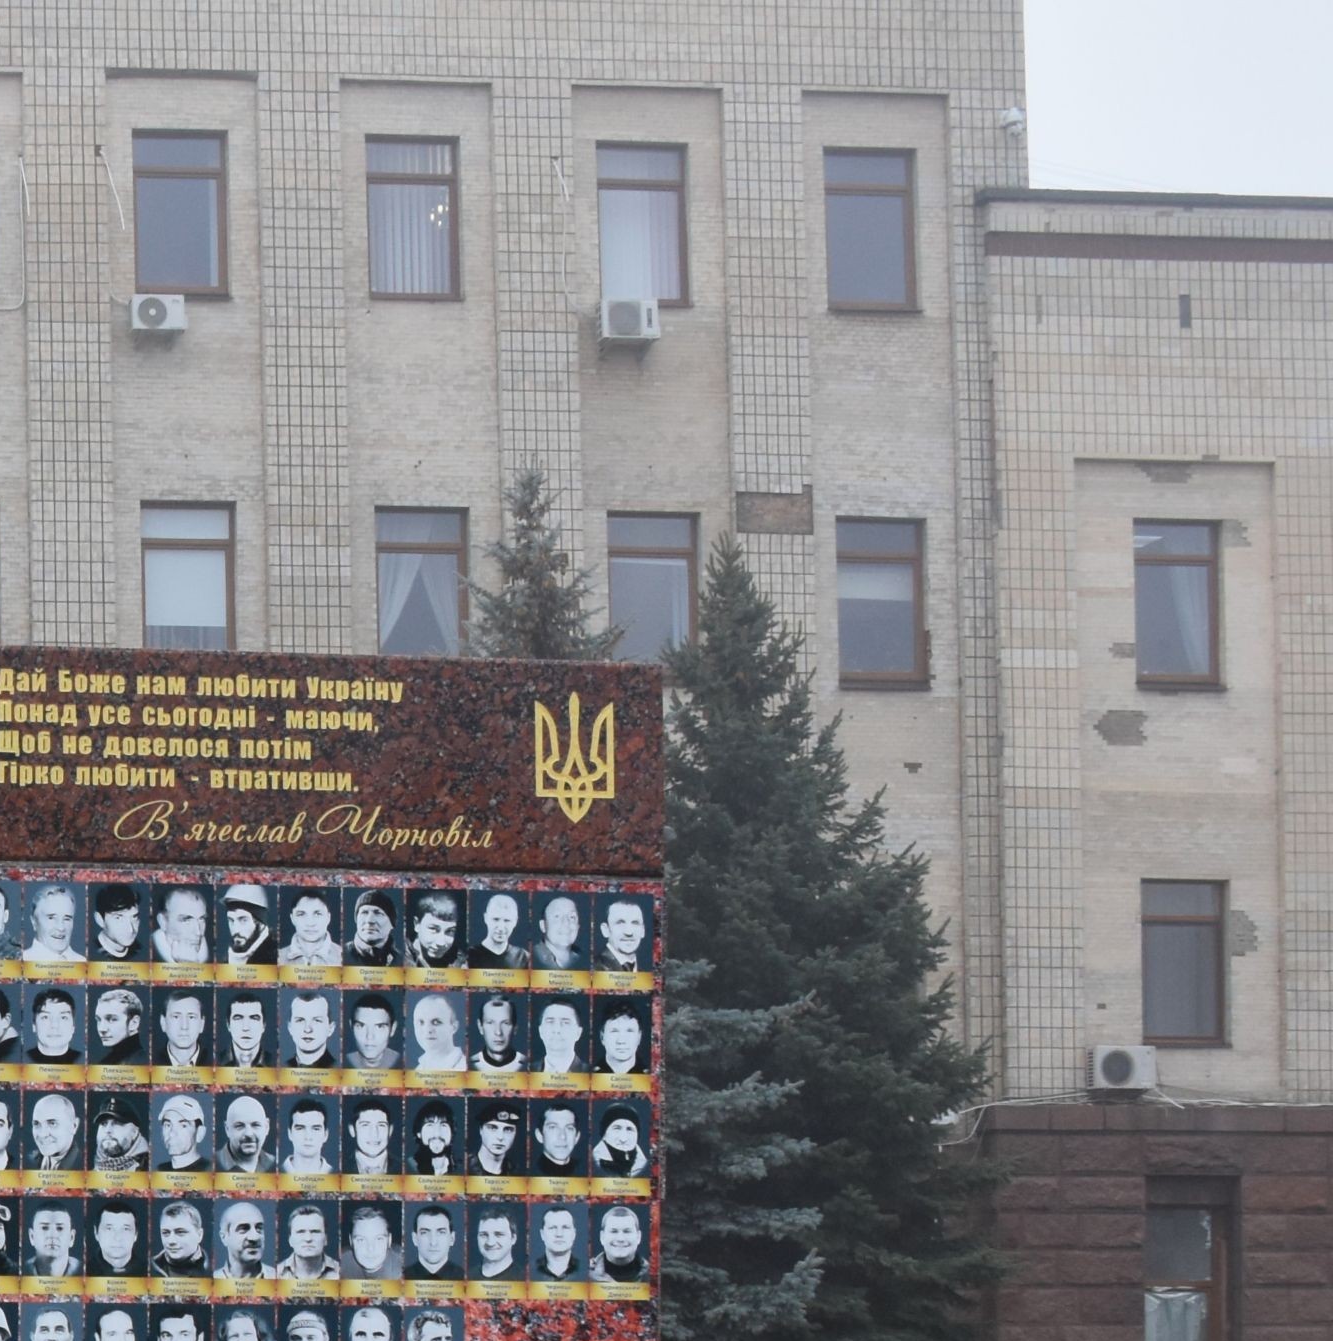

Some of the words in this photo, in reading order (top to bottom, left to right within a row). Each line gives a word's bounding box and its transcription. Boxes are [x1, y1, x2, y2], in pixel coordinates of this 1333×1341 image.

[58, 669, 126, 694] Боже
[136, 675, 187, 696] нам
[197, 673, 296, 698] любити
[307, 676, 404, 703] Україну
[87, 704, 132, 727] усе
[142, 705, 256, 729] сьогодні
[285, 709, 379, 735] маючи,
[62, 734, 93, 755] не
[103, 735, 229, 758] довелося
[239, 737, 312, 760] потім
[76, 762, 176, 788] любити
[210, 768, 360, 793] втративши.
[113, 799, 303, 843] В'ячеслав
[316, 805, 493, 849] Чорновіл
